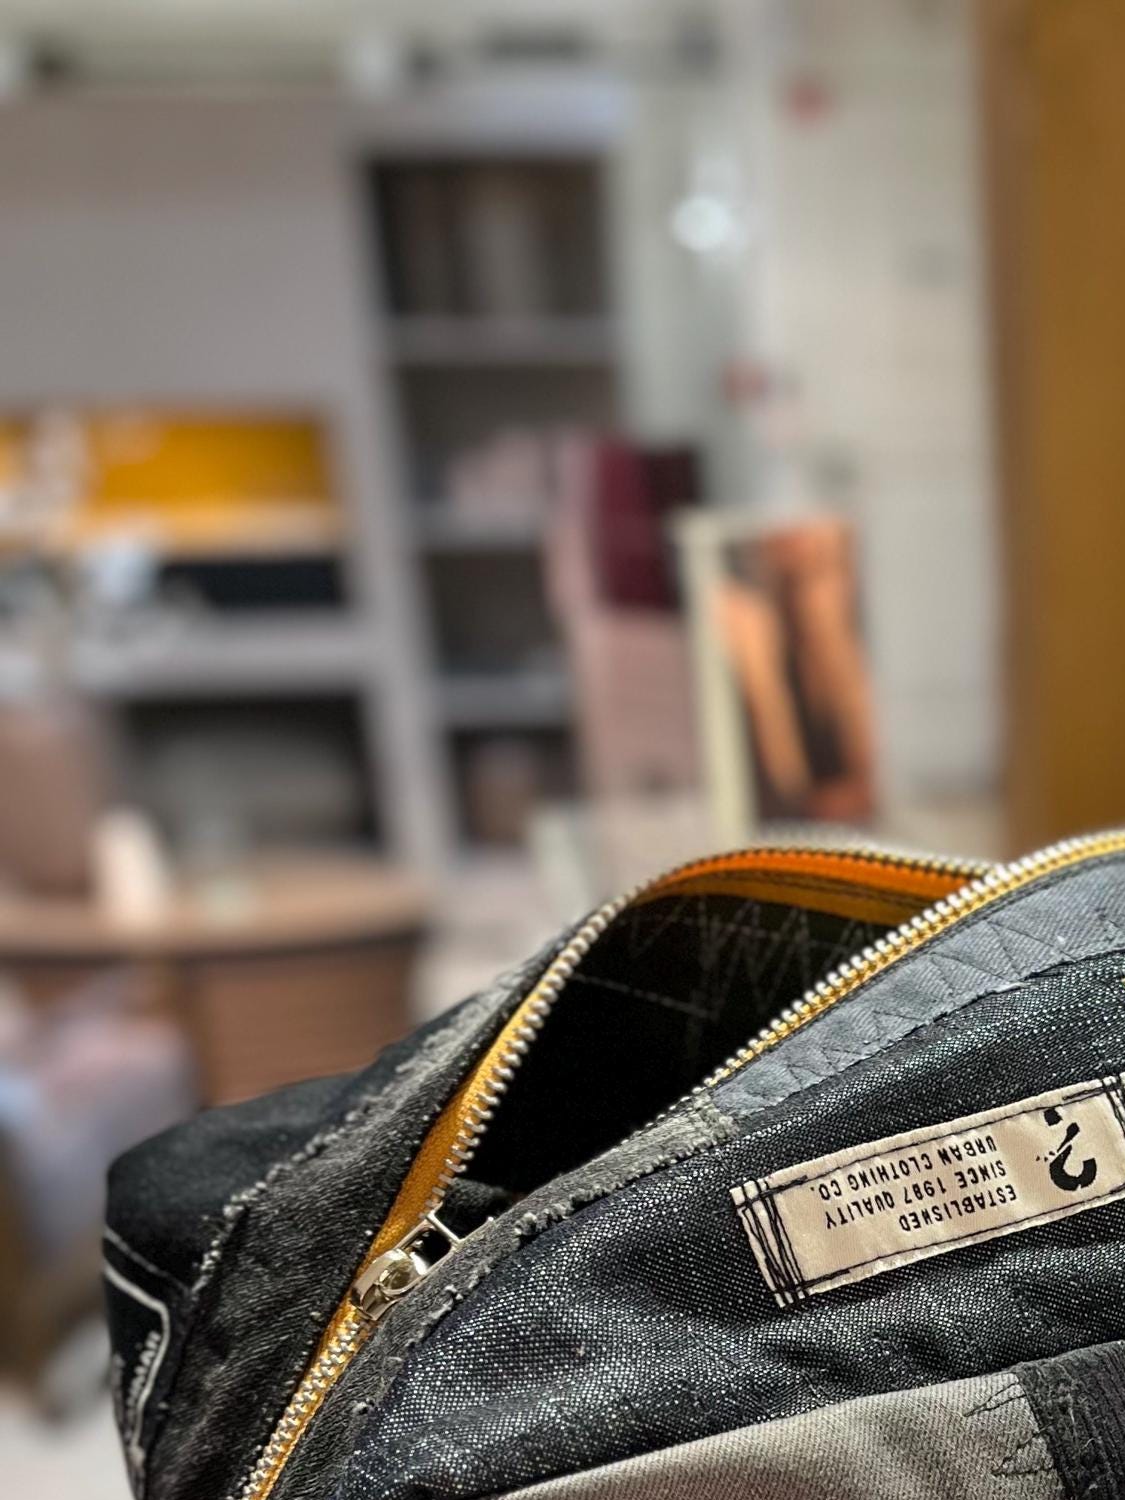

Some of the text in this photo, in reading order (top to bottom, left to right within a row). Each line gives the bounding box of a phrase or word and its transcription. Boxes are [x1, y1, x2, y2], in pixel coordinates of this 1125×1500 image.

[810, 1134, 996, 1203] URBAN CLOTHING CO.
[954, 1158, 1005, 1189] SINCE
[822, 1189, 894, 1229] QUALITY
[897, 1183, 1016, 1232] ESTABLISHED
